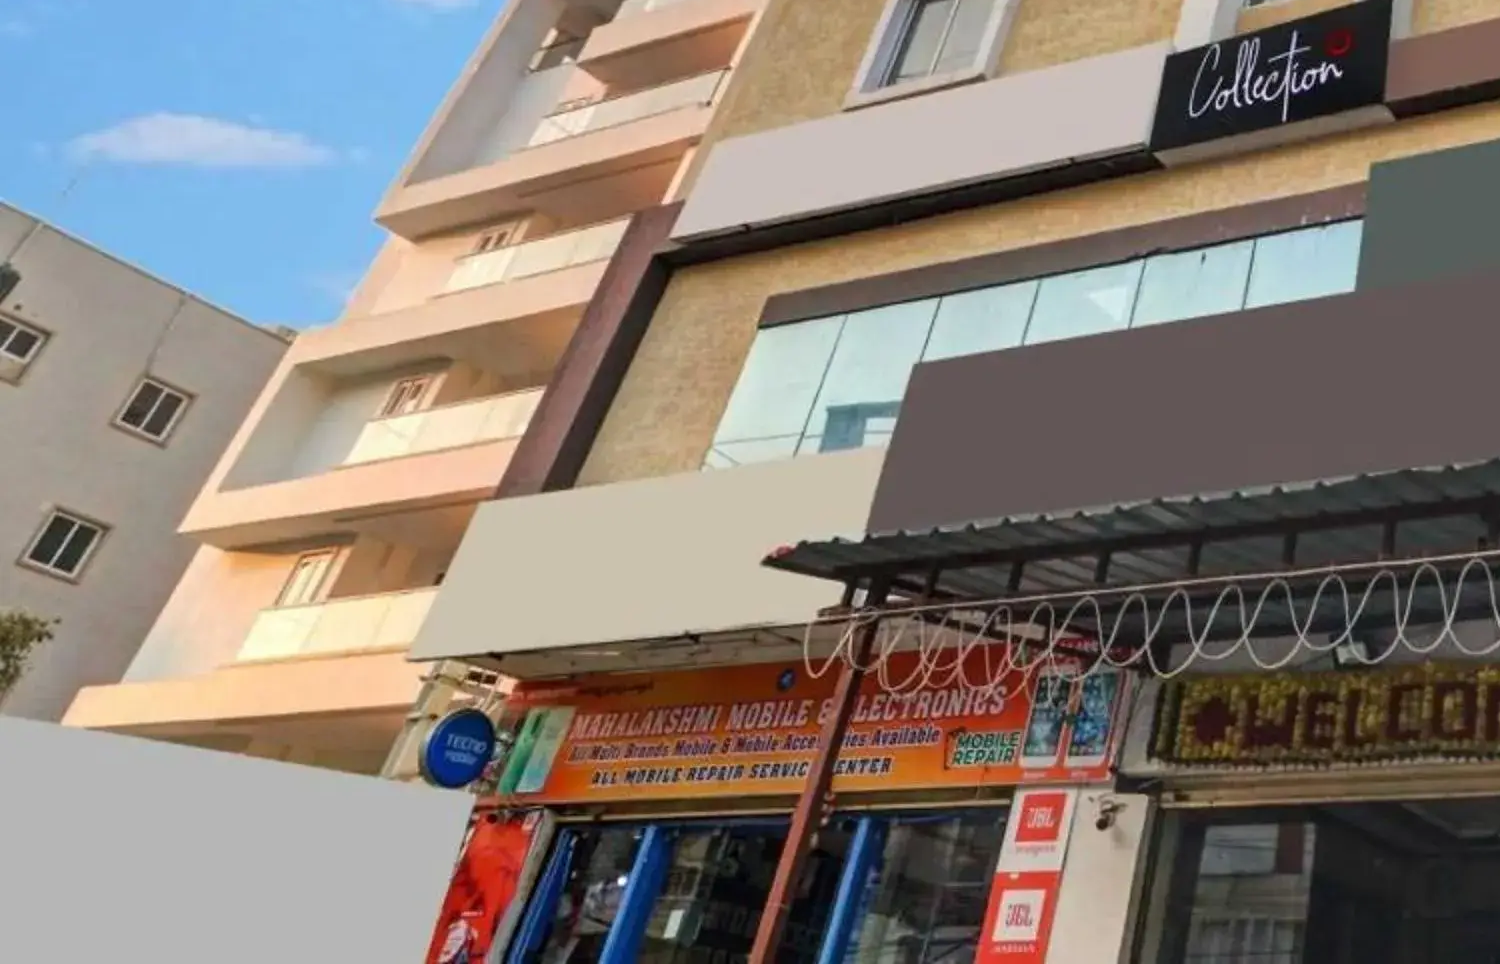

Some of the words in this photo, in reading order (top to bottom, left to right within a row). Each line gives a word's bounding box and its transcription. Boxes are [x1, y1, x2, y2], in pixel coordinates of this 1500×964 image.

[1189, 30, 1343, 122] Collection
[568, 704, 722, 740] MAHALAKSHMI
[726, 699, 814, 733] MOBILE
[846, 685, 1008, 724] LECTRONICS
[871, 726, 940, 746] Available
[957, 731, 1021, 748] MOBILE
[952, 748, 1016, 765] REPAIR
[591, 771, 617, 785] ALL
[624, 767, 683, 784] MOBILE
[686, 764, 745, 781] REPAIR
[748, 761, 810, 779] SERVIC
[833, 756, 892, 775] ENTER
